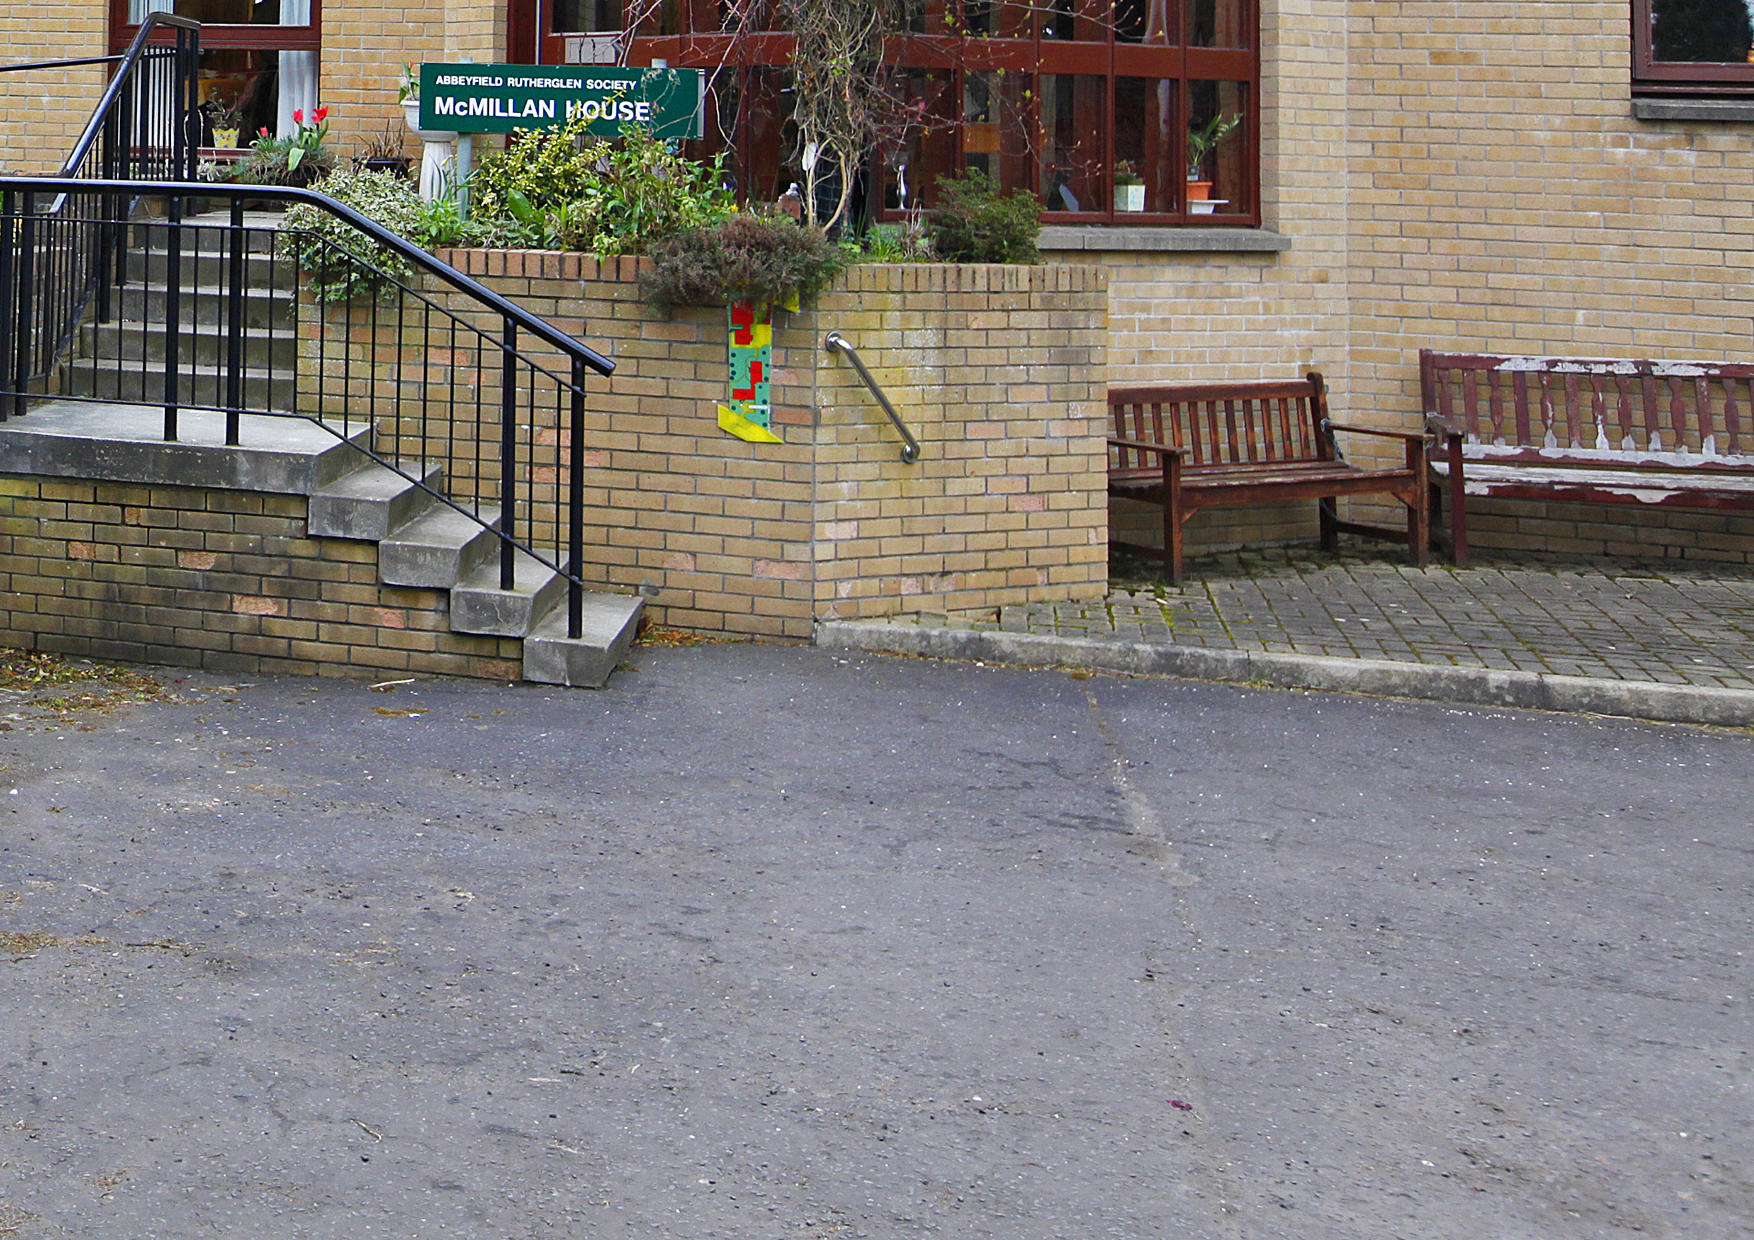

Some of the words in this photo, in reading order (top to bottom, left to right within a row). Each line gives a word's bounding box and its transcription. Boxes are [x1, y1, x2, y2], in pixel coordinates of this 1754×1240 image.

[436, 75, 503, 86] ABBEYFIELD
[507, 77, 582, 88] RUTHERGLEN
[586, 79, 637, 90] SOCIETY
[435, 96, 555, 118] McMILLAN
[566, 100, 650, 121] HOUSE
